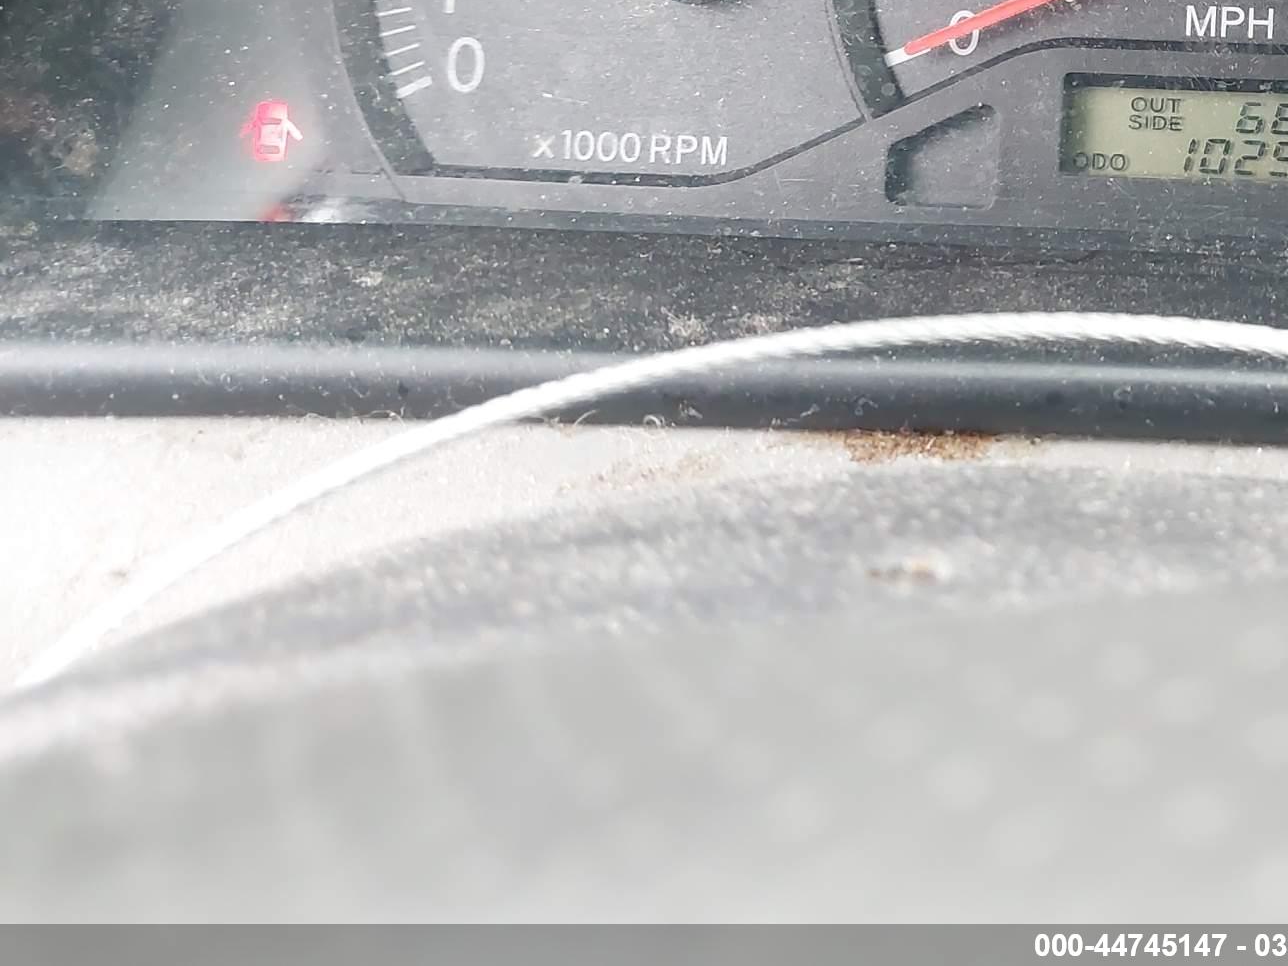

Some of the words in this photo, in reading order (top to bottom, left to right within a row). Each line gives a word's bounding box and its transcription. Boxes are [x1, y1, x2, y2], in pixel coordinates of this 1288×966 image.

[1185, 5, 1274, 39] MPH
[448, 38, 484, 91] 0
[1131, 97, 1182, 113] OUT
[1128, 114, 1184, 131] SIDE
[650, 136, 728, 166] RPM
[1072, 153, 1127, 170] ODO
